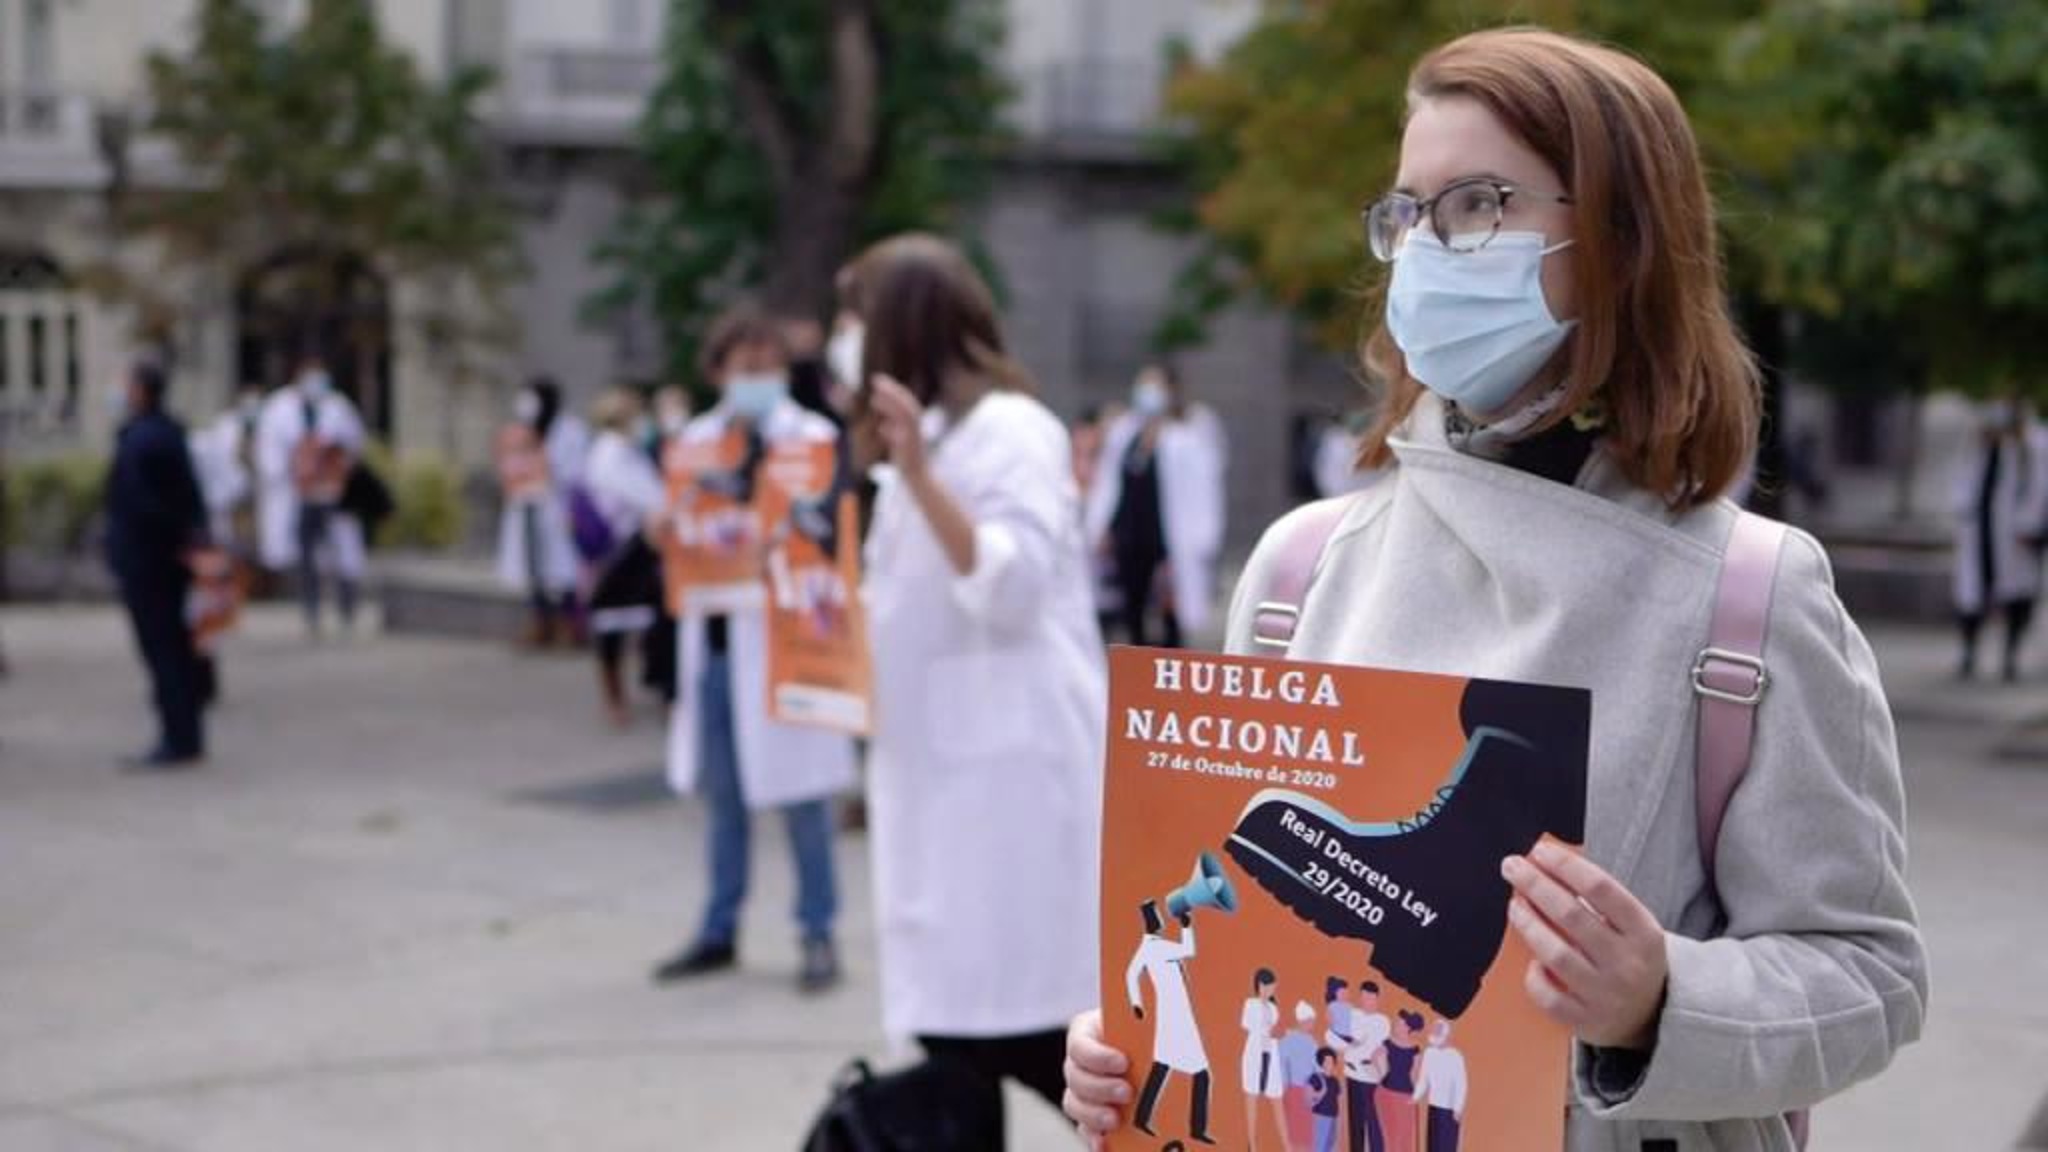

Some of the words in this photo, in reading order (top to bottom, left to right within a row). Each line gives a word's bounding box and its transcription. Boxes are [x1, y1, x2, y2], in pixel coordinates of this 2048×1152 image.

[1154, 658, 1340, 706] HUELGA
[1125, 707, 1364, 765] NACIONAL
[1147, 752, 1168, 767] 27
[1170, 754, 1191, 771] de
[1194, 757, 1262, 780] Octubre
[1266, 766, 1287, 783] de
[1292, 769, 1336, 788] 2020
[1280, 809, 1325, 848] Real
[1324, 838, 1400, 899] Decreto
[1401, 890, 1438, 927] Ley
[1302, 861, 1385, 925] 29/2020
